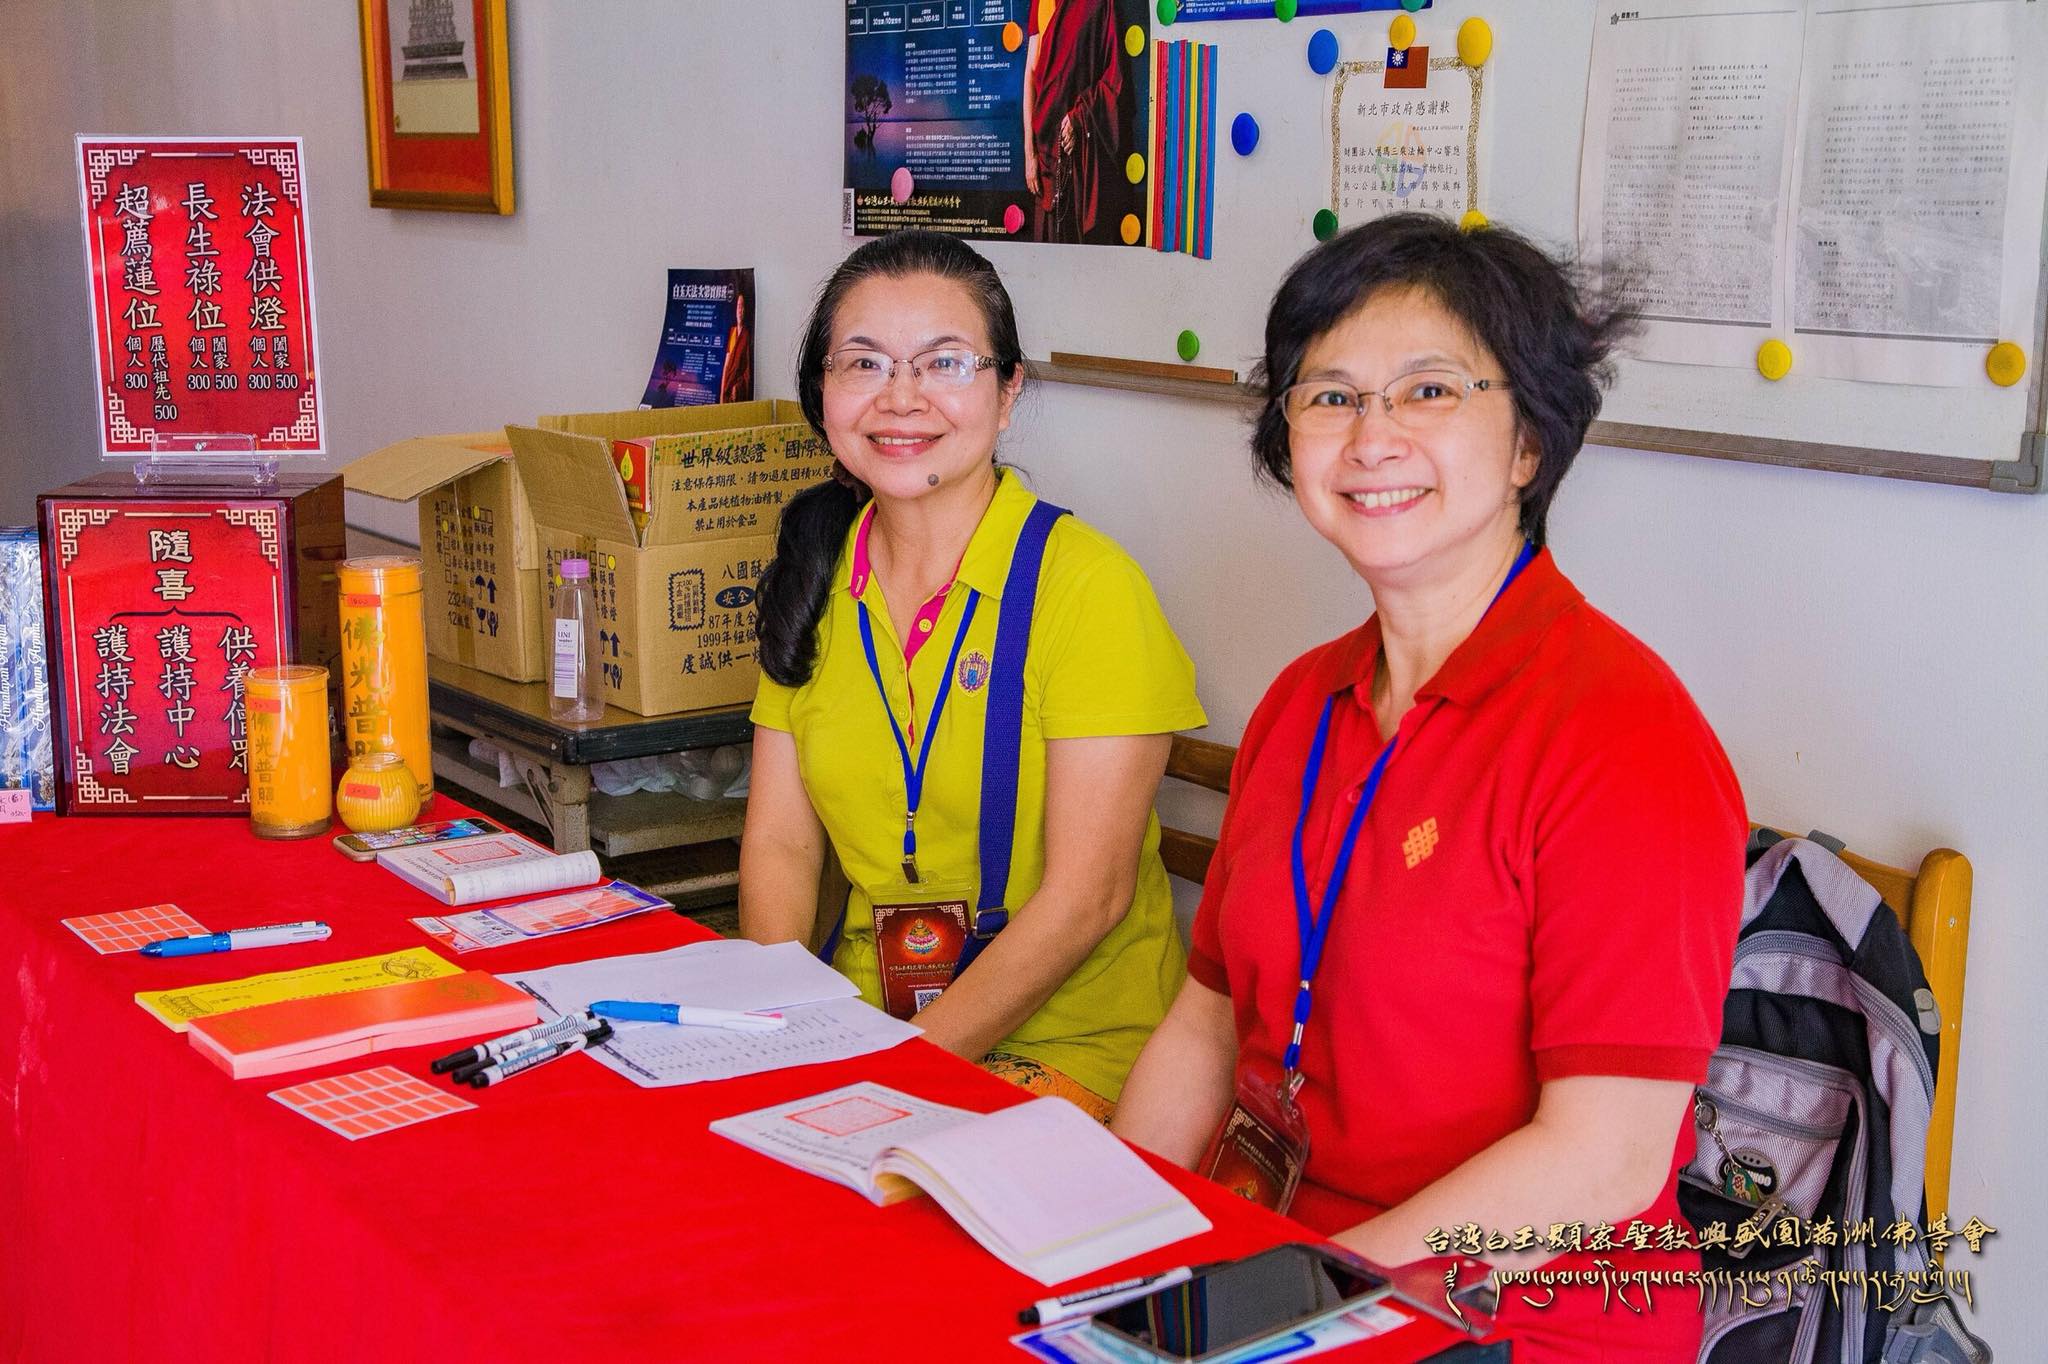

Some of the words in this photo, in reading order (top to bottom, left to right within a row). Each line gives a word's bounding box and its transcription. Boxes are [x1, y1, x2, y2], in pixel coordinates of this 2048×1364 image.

[1357, 101, 1450, 116] 新北市政府感謝狀
[114, 182, 163, 331] 超薦蓮位
[181, 182, 226, 331] 長生祿位
[240, 182, 287, 331] 法會供燈
[125, 336, 145, 368] 個人
[150, 335, 171, 400] 歷代祖先
[189, 336, 208, 368] 個人
[250, 336, 269, 368] 個人
[125, 374, 147, 389] 300
[188, 374, 210, 390] 300
[215, 374, 238, 390] 500
[248, 374, 271, 390] 300
[275, 374, 298, 390] 500
[154, 404, 178, 420] 500
[150, 530, 195, 600] 隨喜
[722, 590, 749, 606] 安全
[93, 625, 139, 775] 護持法會
[156, 625, 200, 769] 護持中心
